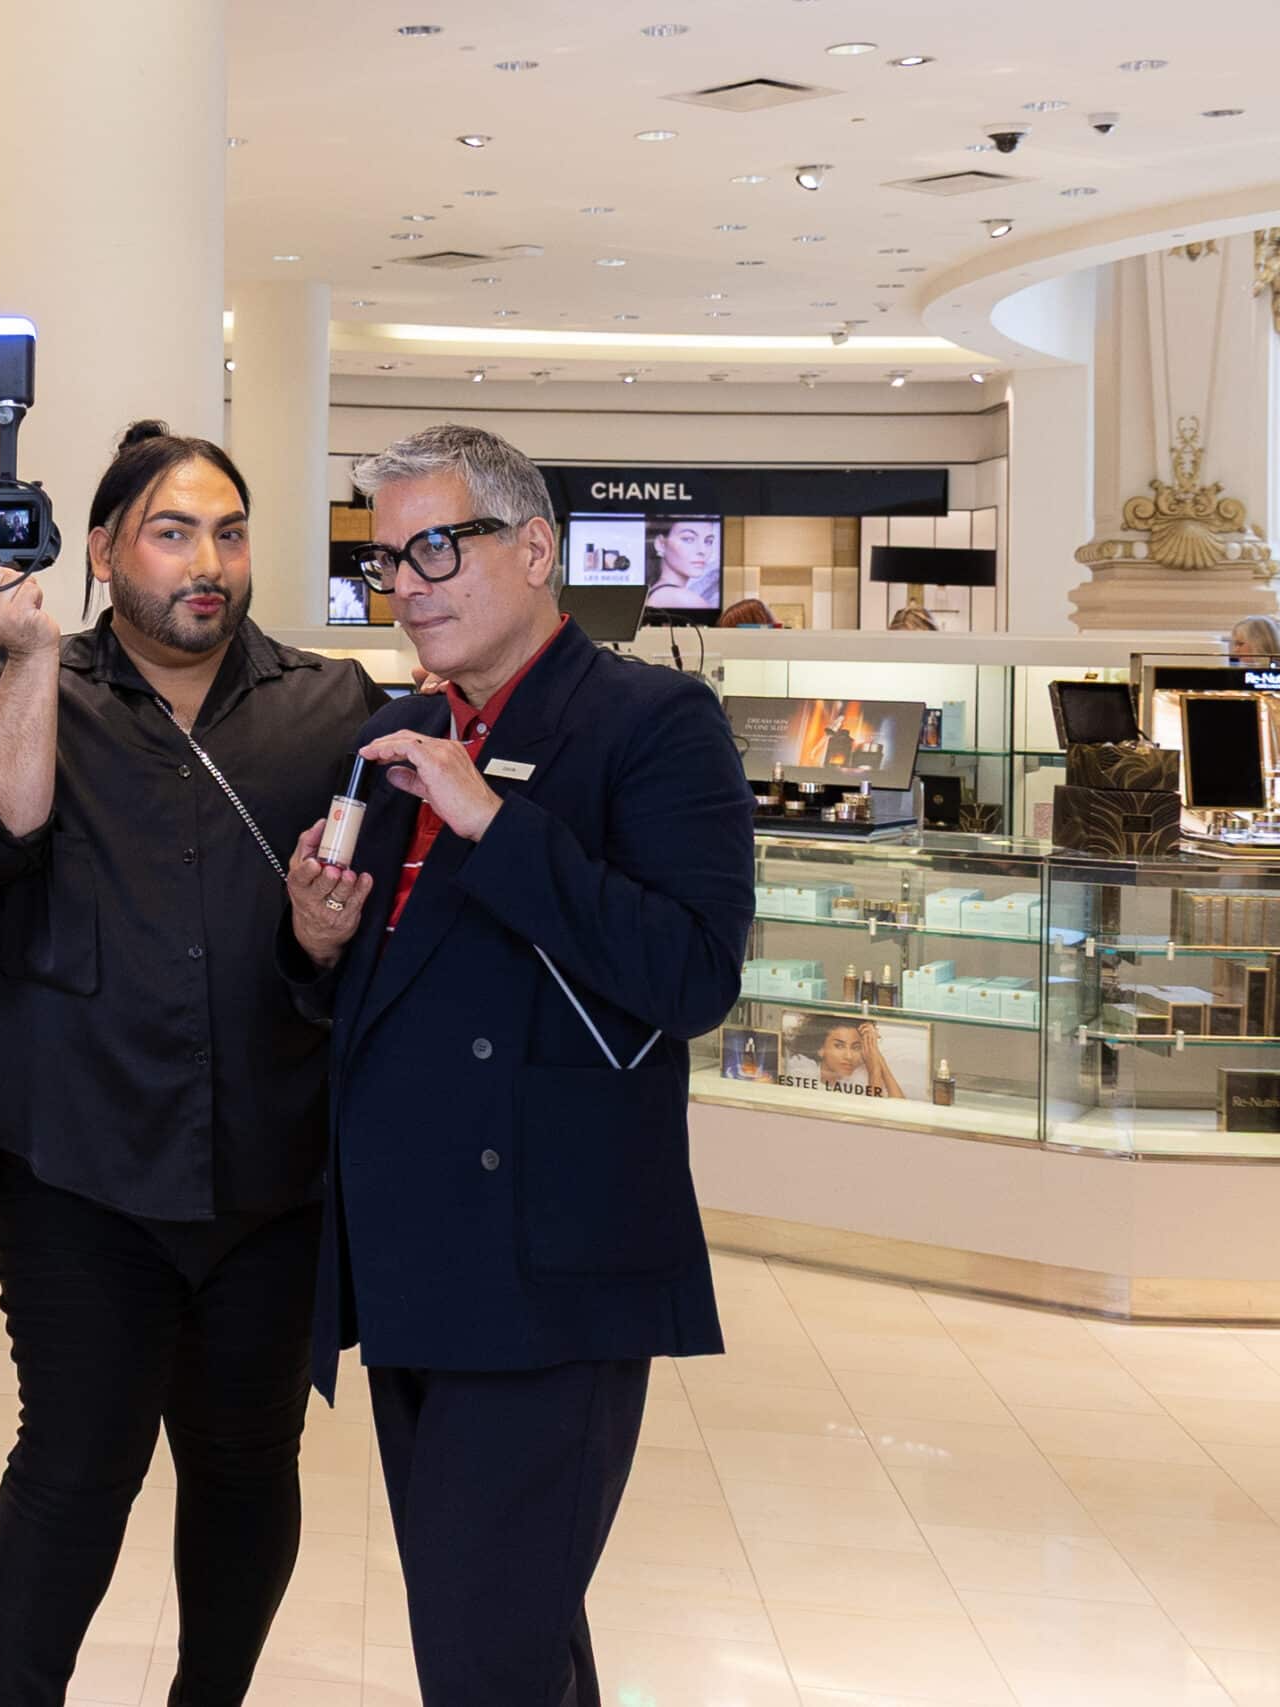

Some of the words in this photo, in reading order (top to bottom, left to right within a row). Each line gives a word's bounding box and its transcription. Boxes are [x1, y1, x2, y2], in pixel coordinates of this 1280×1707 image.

[591, 482, 692, 500] CHANEL
[778, 1075, 818, 1090] ESTEE
[825, 1080, 883, 1098] LAUDER
